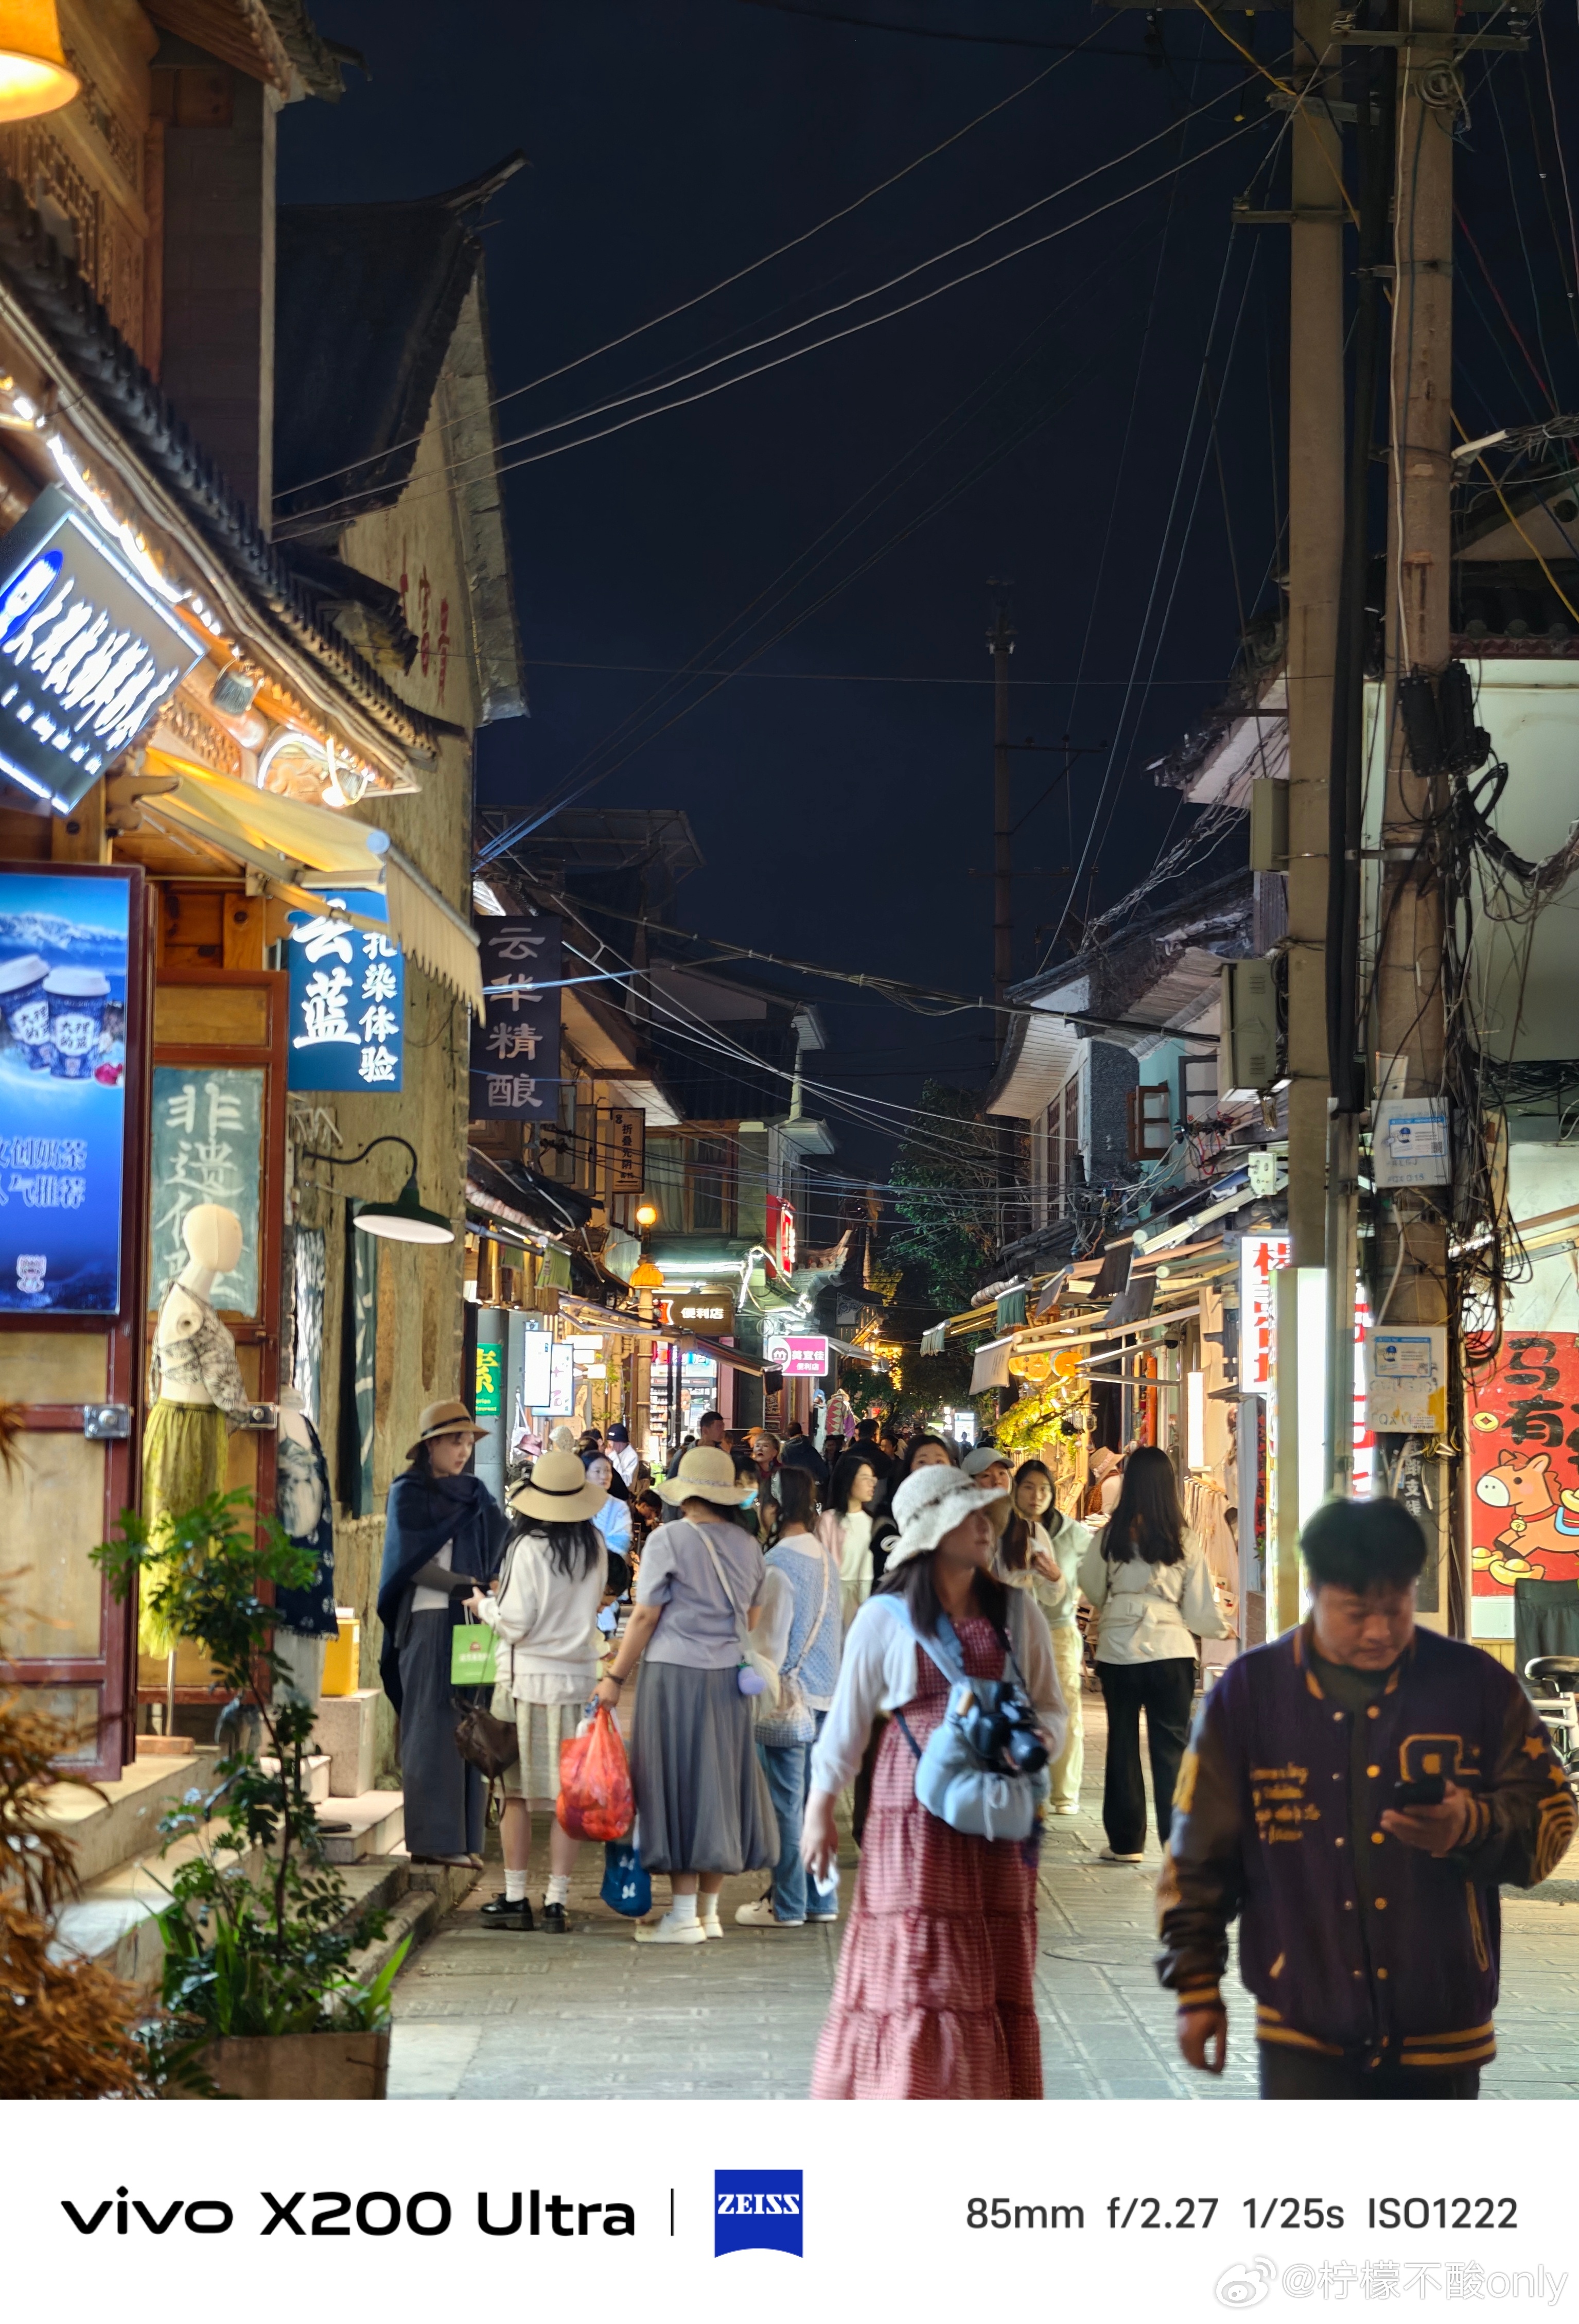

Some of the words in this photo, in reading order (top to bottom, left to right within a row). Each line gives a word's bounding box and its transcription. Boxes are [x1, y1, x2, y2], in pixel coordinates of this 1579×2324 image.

[488, 926, 546, 1109] 云华精酿
[680, 1308, 725, 1320] 便利店
[792, 1350, 825, 1361] 美宜佳
